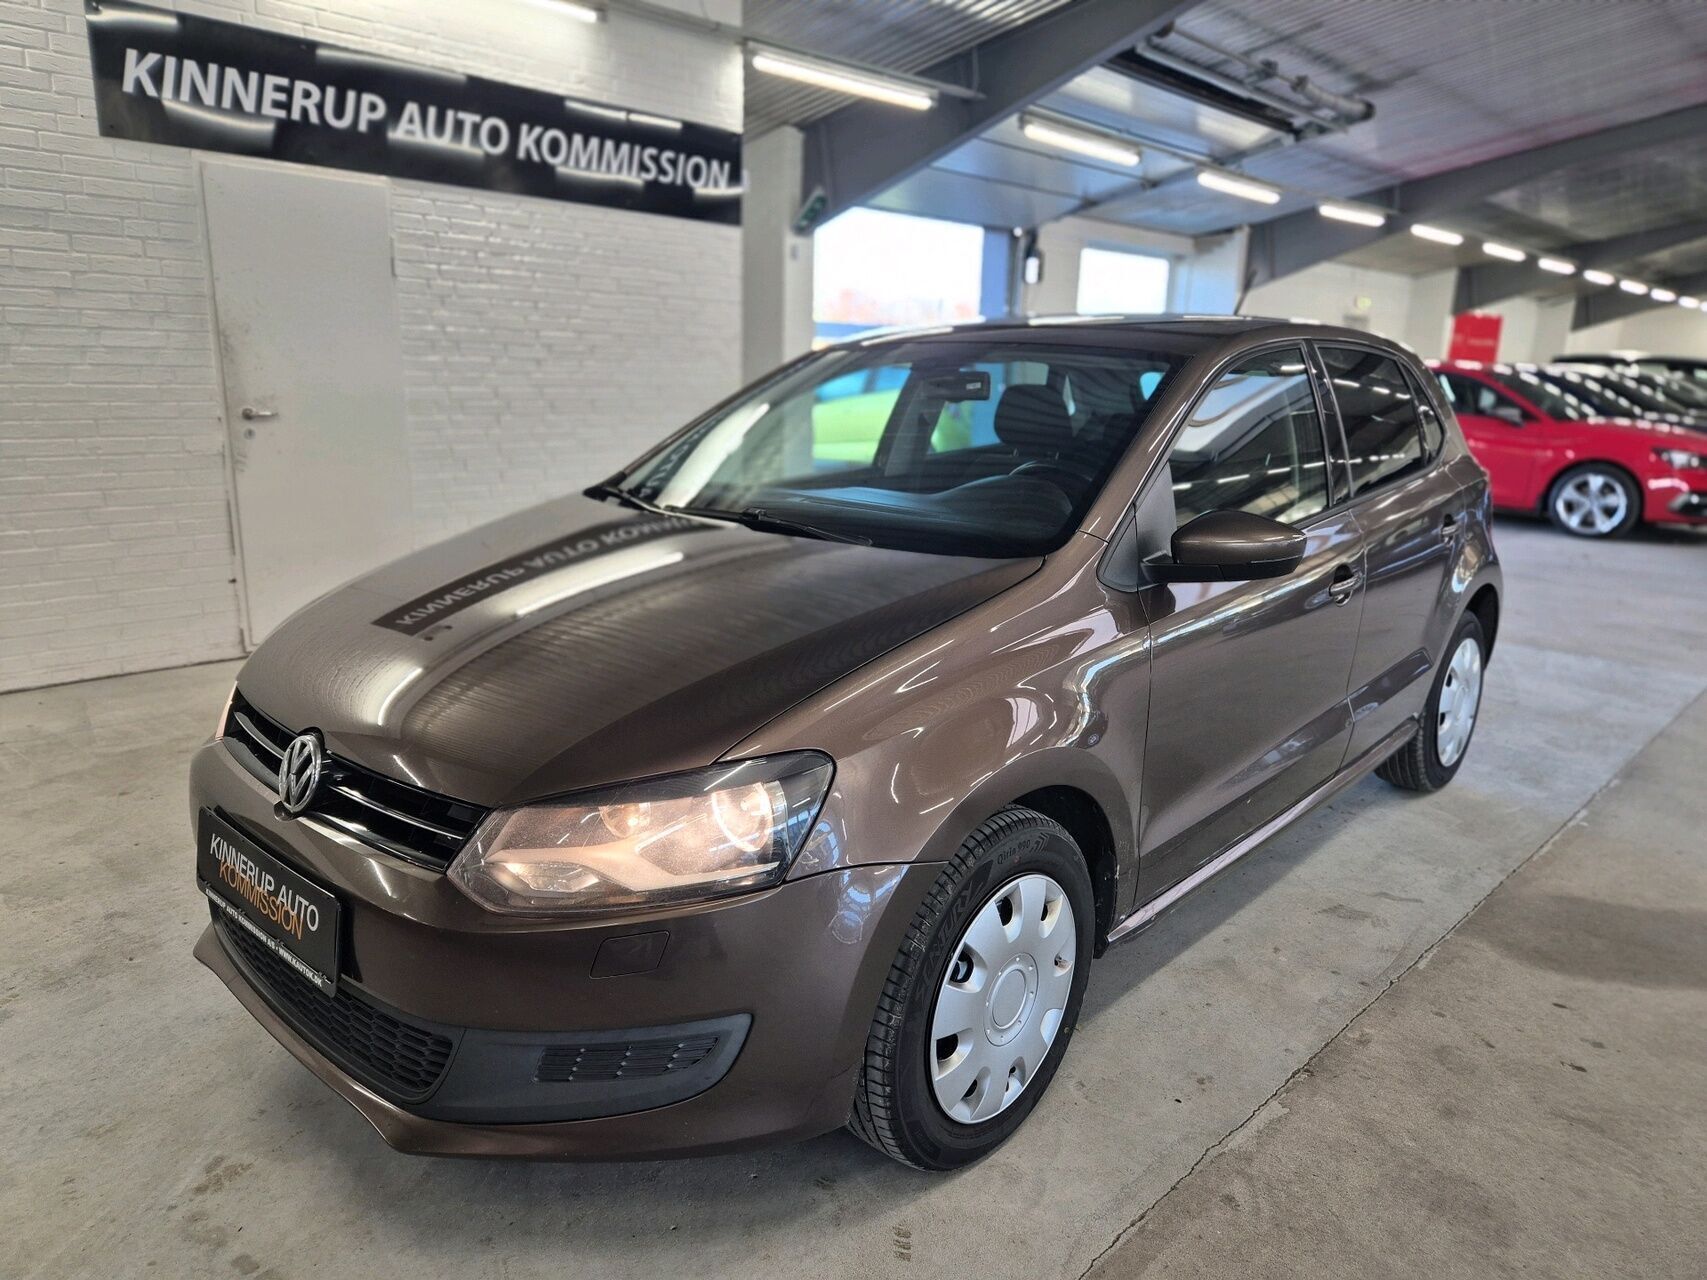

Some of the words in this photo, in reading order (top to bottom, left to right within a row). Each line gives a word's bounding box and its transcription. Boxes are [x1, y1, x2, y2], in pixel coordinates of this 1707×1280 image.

[122, 47, 387, 134] KINNERUP
[394, 101, 509, 157] AUTO
[517, 123, 731, 191] KOMMISSION
[210, 833, 275, 893] KINNERUP
[276, 884, 319, 932] AUTO
[219, 860, 304, 941] KOMMISSION
